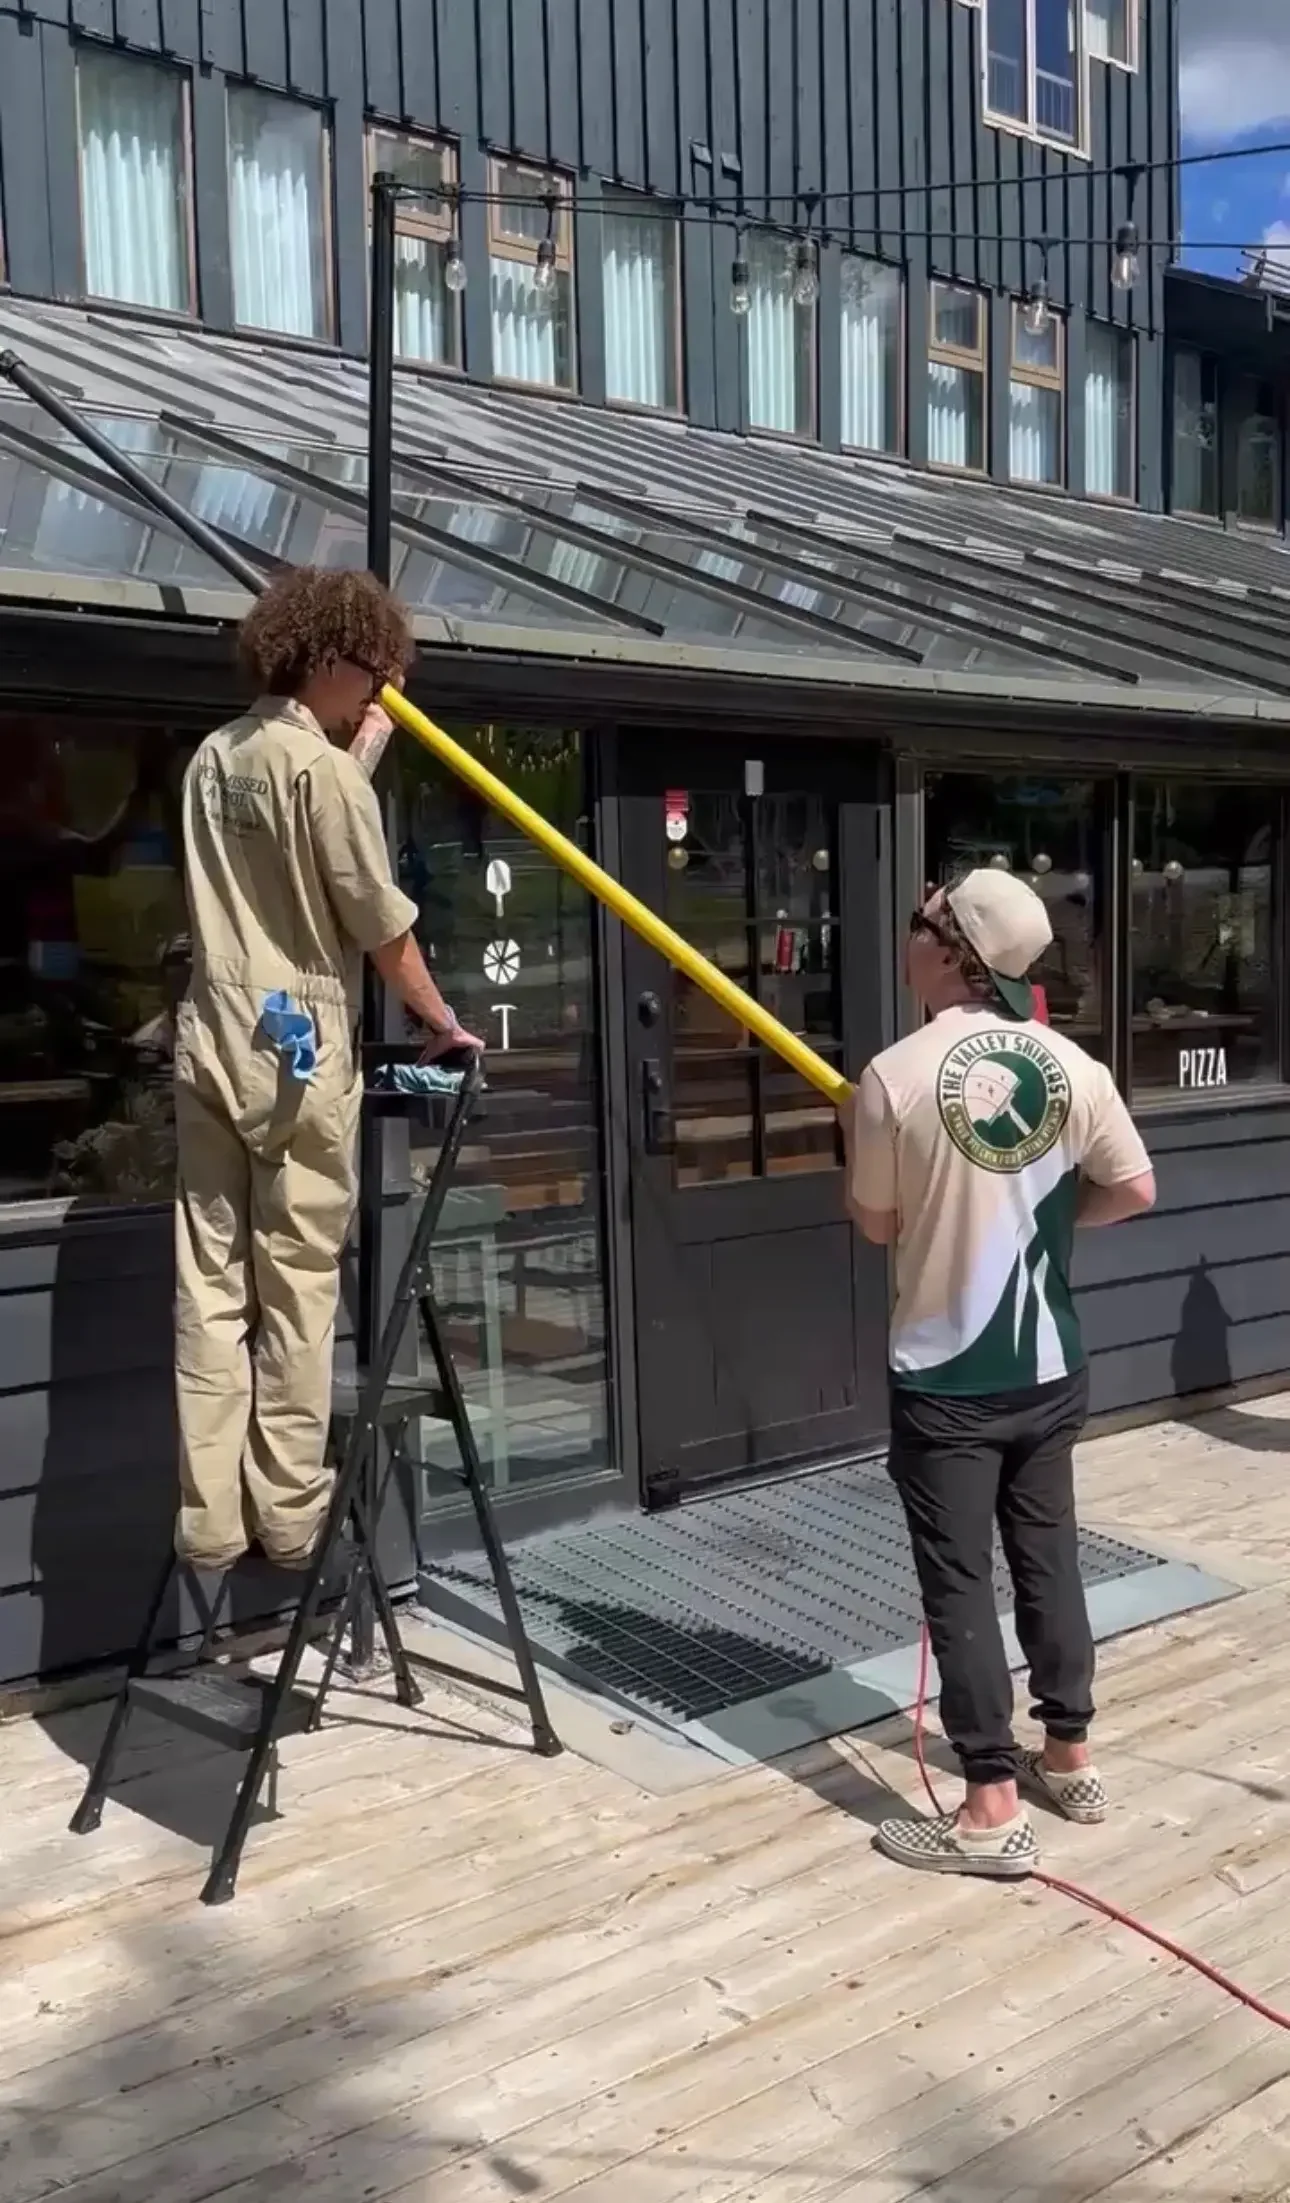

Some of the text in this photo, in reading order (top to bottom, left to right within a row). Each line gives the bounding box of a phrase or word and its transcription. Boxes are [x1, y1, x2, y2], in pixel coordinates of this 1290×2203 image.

[942, 1034, 1067, 1101] THE VALLEY SHINERS
[1179, 1047, 1227, 1089] PIZZA
